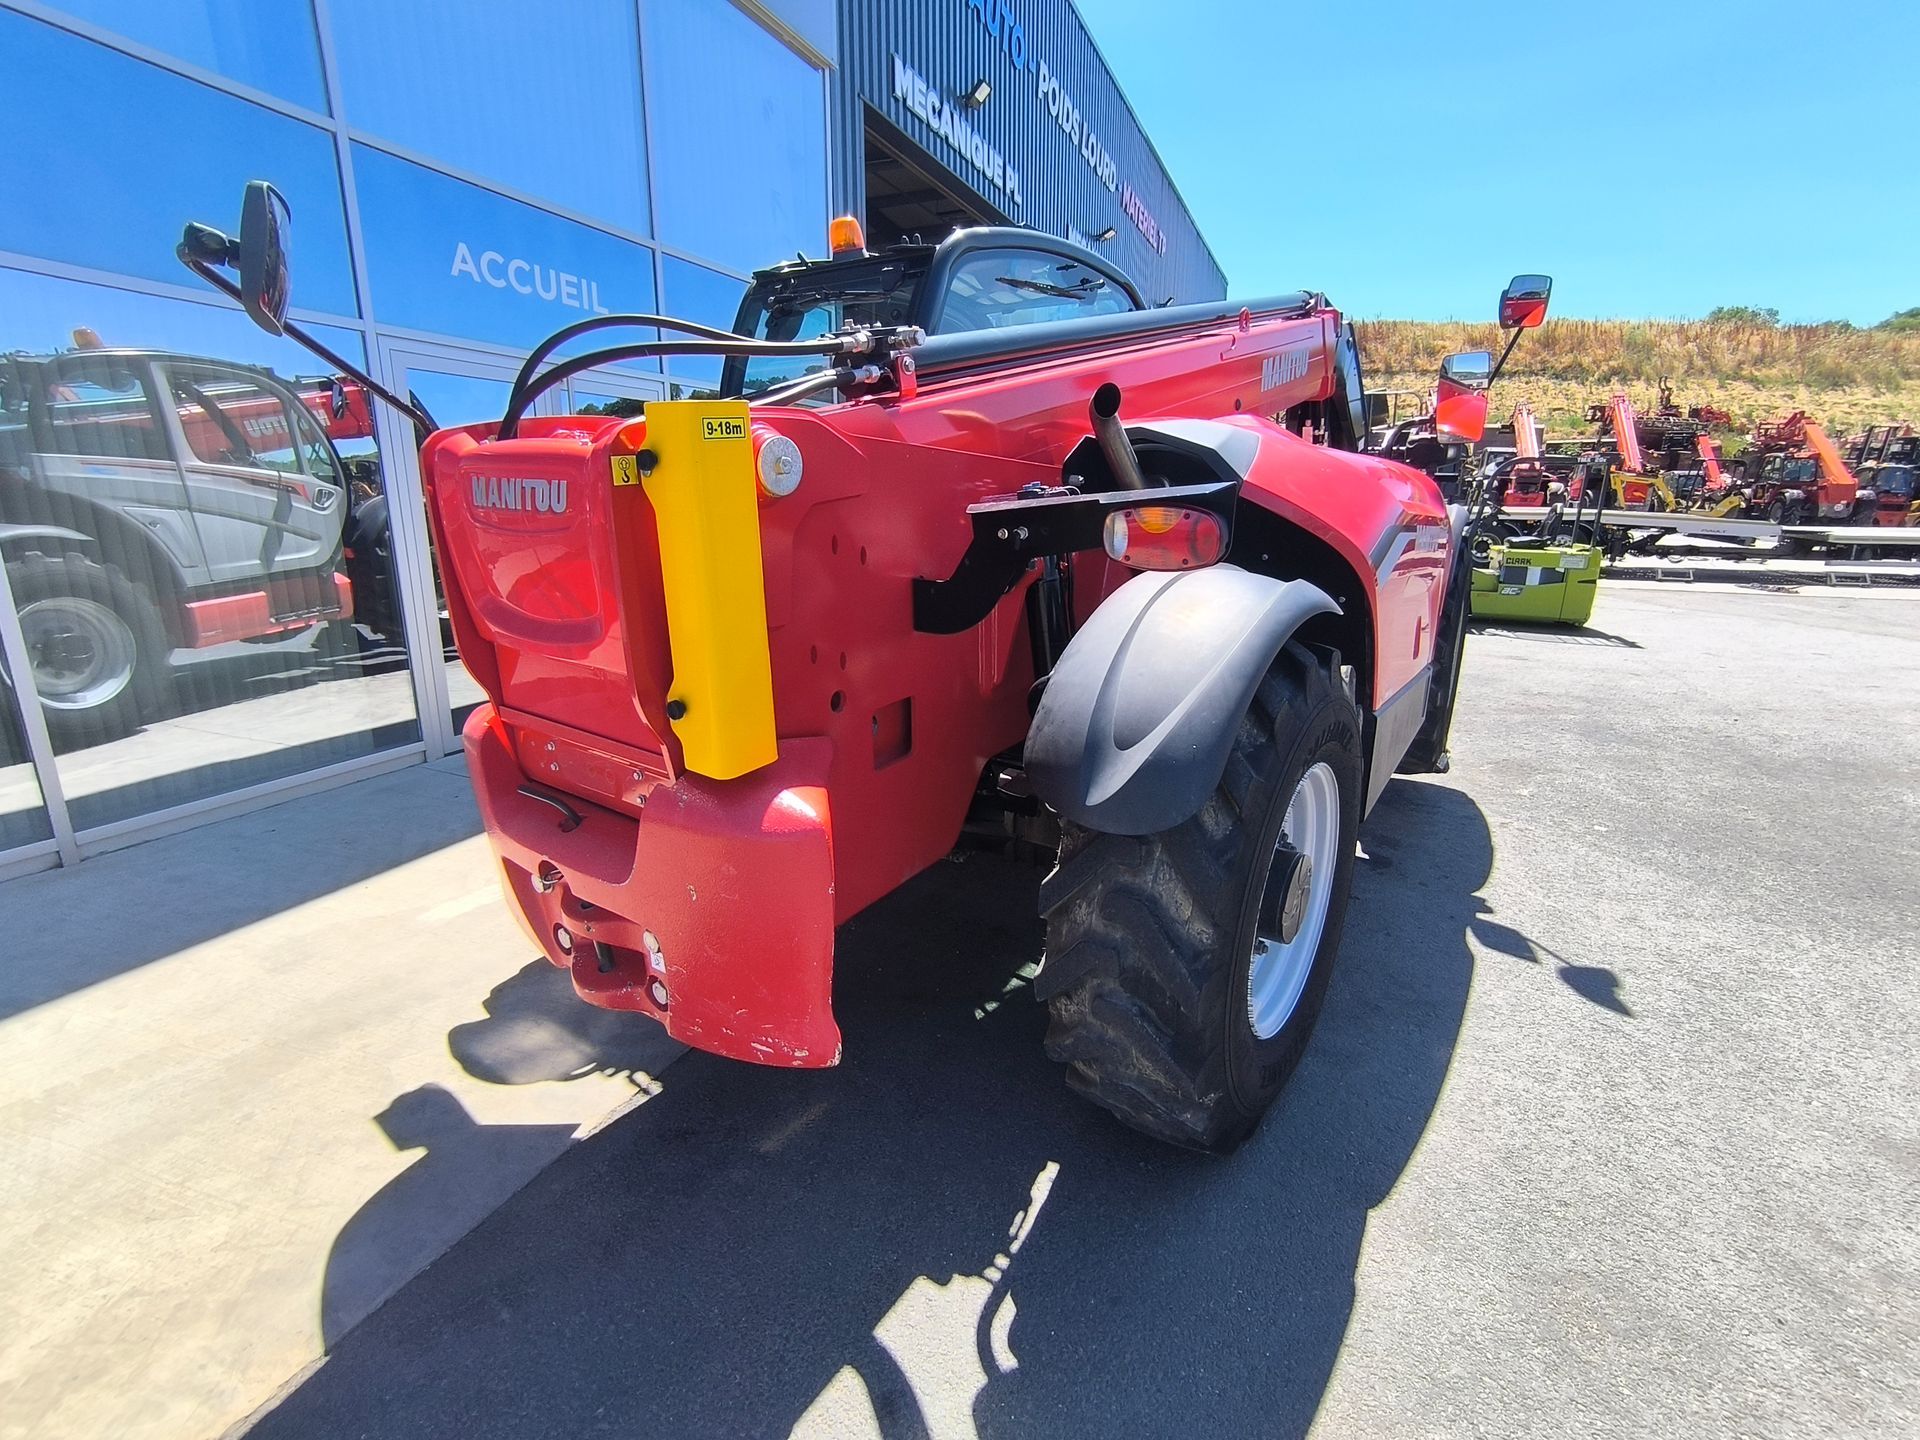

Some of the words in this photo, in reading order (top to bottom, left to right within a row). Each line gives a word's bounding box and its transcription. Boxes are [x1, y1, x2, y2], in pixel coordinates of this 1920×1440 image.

[891, 52, 1004, 191] MECANIQUE
[1005, 160, 1023, 206] PL
[1038, 58, 1081, 146] POIDS
[1081, 121, 1117, 193] LOURD
[1122, 180, 1157, 250] MATERIEL
[1158, 229, 1168, 258] TP
[450, 241, 610, 315] ACCUEIL
[1260, 350, 1310, 393] MANITOU
[705, 420, 743, 437] 9-18m
[471, 474, 568, 515] MANITOU
[1505, 557, 1532, 565] CLARK
